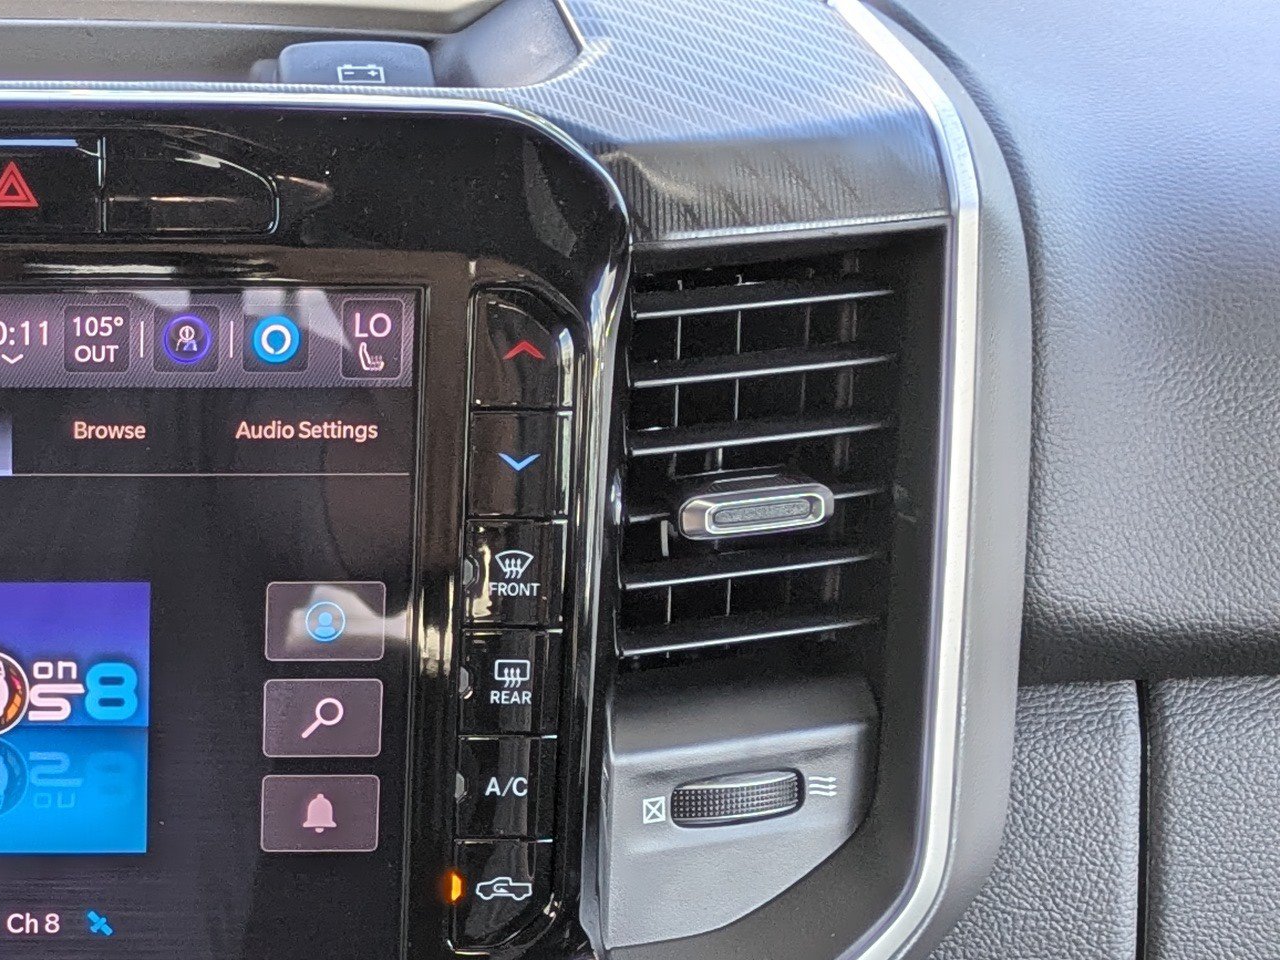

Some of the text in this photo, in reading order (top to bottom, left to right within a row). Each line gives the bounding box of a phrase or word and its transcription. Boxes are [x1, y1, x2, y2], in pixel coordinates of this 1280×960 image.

[354, 312, 392, 338] LO
[74, 344, 119, 364] OUT
[73, 420, 146, 441] Browse
[235, 420, 379, 447] Audio Settings
[489, 582, 540, 597] FRONT
[84, 661, 139, 721] 8
[490, 690, 532, 705] REAR
[484, 778, 529, 797] A/C
[6, 912, 39, 934] Ch
[44, 912, 61, 934] 8
